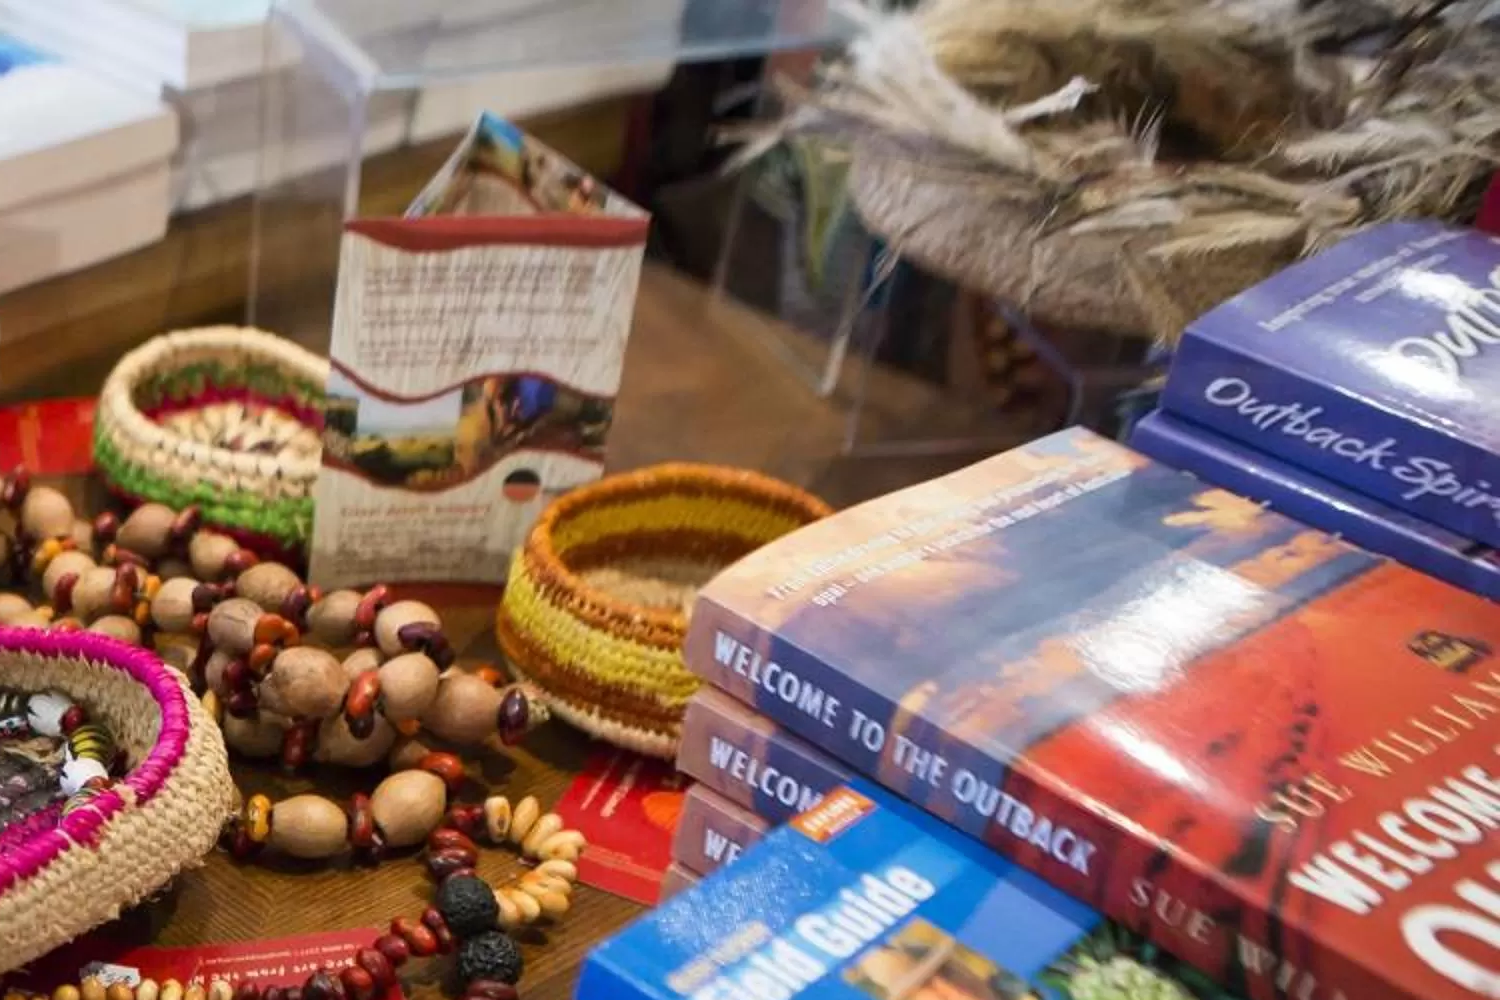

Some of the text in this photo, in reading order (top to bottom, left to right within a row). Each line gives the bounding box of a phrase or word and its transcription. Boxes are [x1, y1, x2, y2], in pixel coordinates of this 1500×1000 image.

[1204, 377, 1397, 471] Outback
[708, 735, 826, 813] WELCOM
[714, 630, 841, 728] WELCOME
[847, 708, 886, 753] TO
[892, 732, 949, 788] THE
[950, 771, 1098, 877] OUTBACK
[1127, 875, 1218, 945] SUE
[1254, 771, 1356, 835] SUE
[793, 864, 937, 960] Guide
